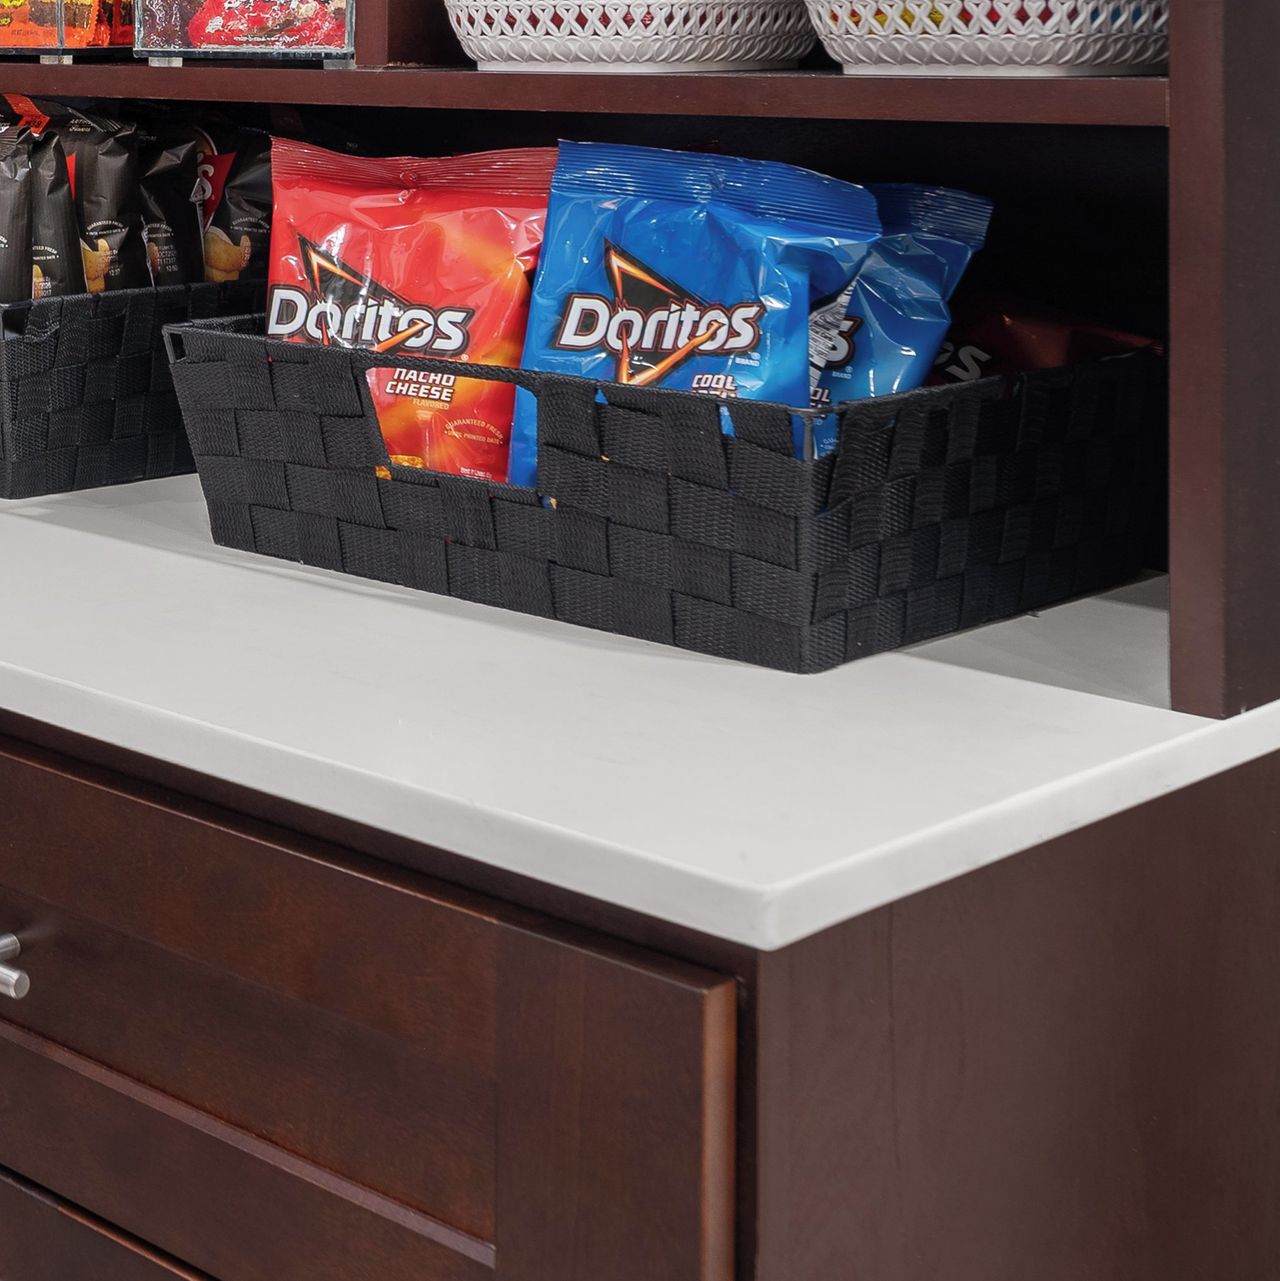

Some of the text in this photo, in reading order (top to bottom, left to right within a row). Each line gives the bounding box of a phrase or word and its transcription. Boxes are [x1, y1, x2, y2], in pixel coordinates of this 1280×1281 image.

[267, 288, 470, 352] Doritos
[561, 293, 765, 355] Doritos
[393, 367, 455, 387] NACHO
[692, 374, 738, 389] COOL
[385, 381, 454, 402] CHEESE
[412, 398, 450, 410] FLAVORED
[444, 417, 504, 440] GUARANTEED FRESH
[463, 433, 486, 443] PRINTED
